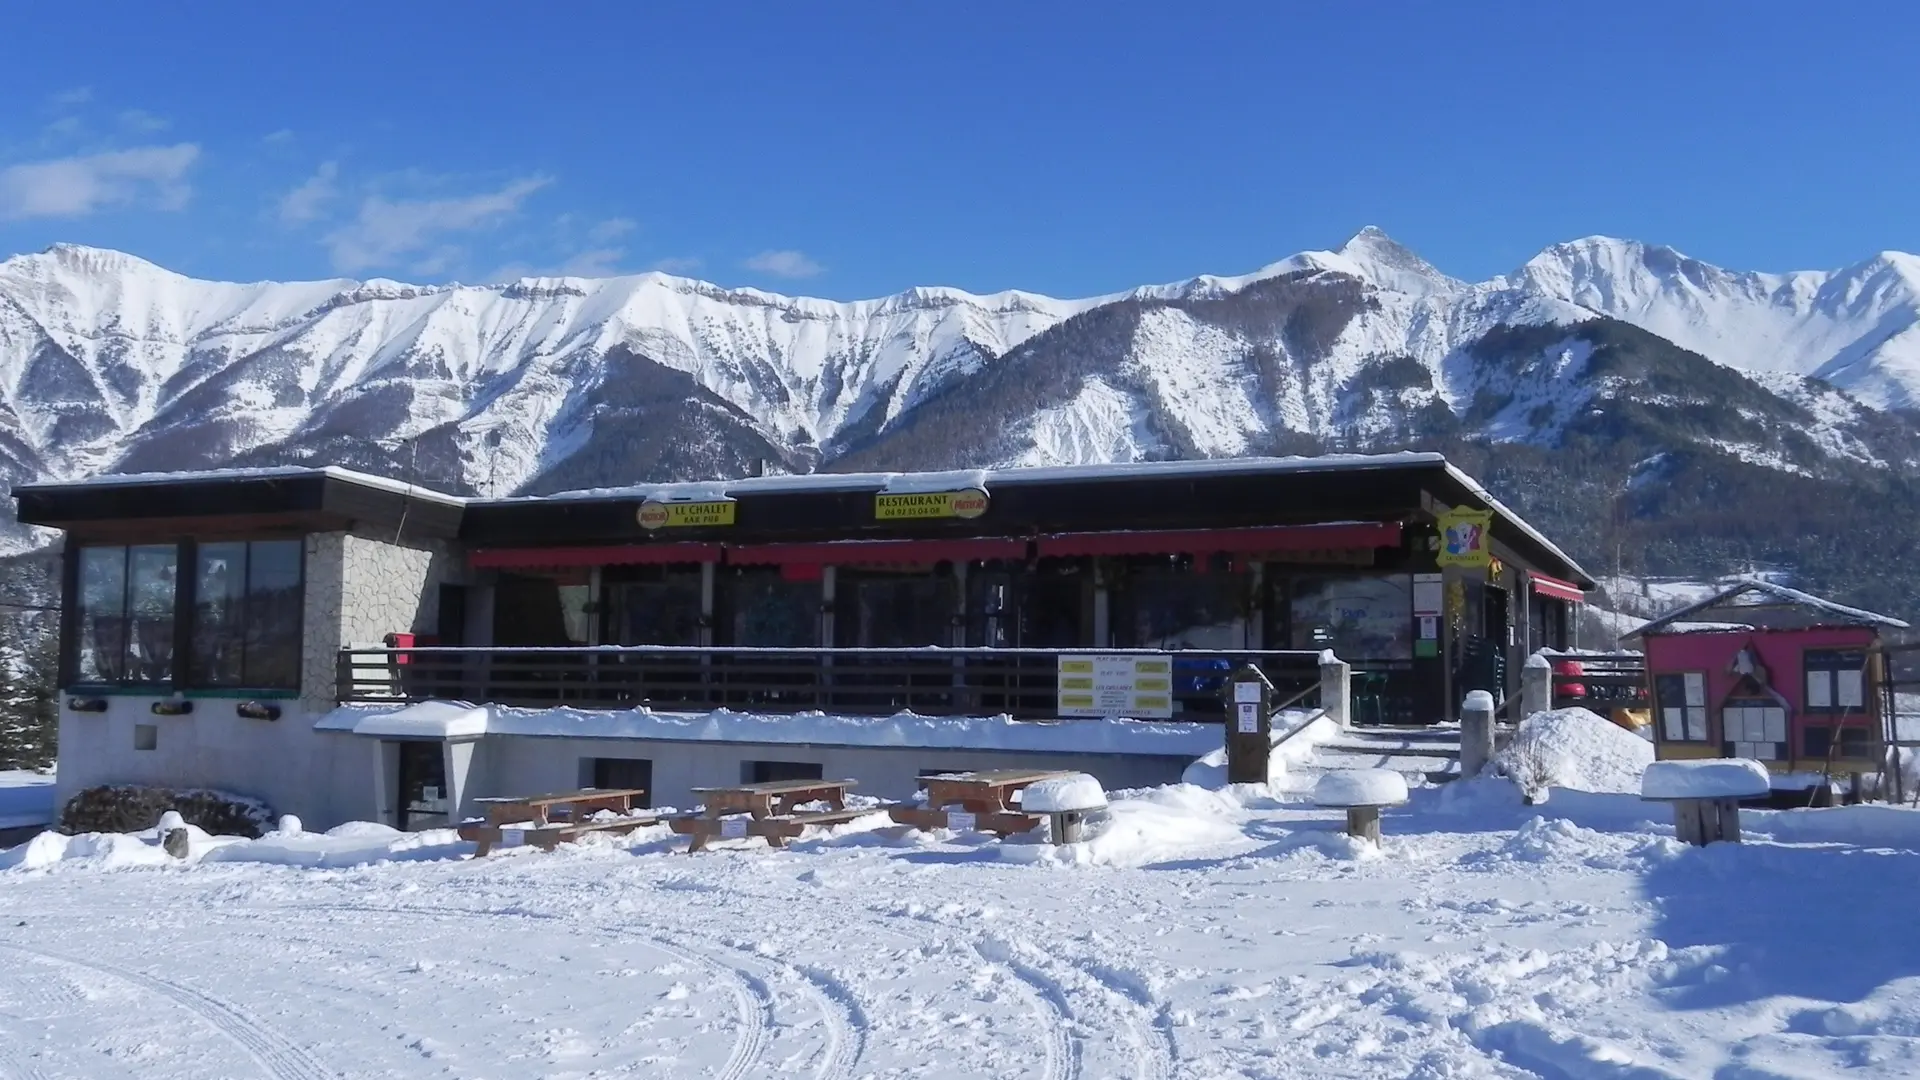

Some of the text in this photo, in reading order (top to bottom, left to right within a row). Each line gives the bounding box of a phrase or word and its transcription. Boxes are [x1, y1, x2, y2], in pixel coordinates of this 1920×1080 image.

[878, 495, 948, 507] RESTAURANT
[675, 504, 728, 515] LE CHALET
[884, 508, 895, 516] 04
[683, 515, 720, 524] BAR PUB
